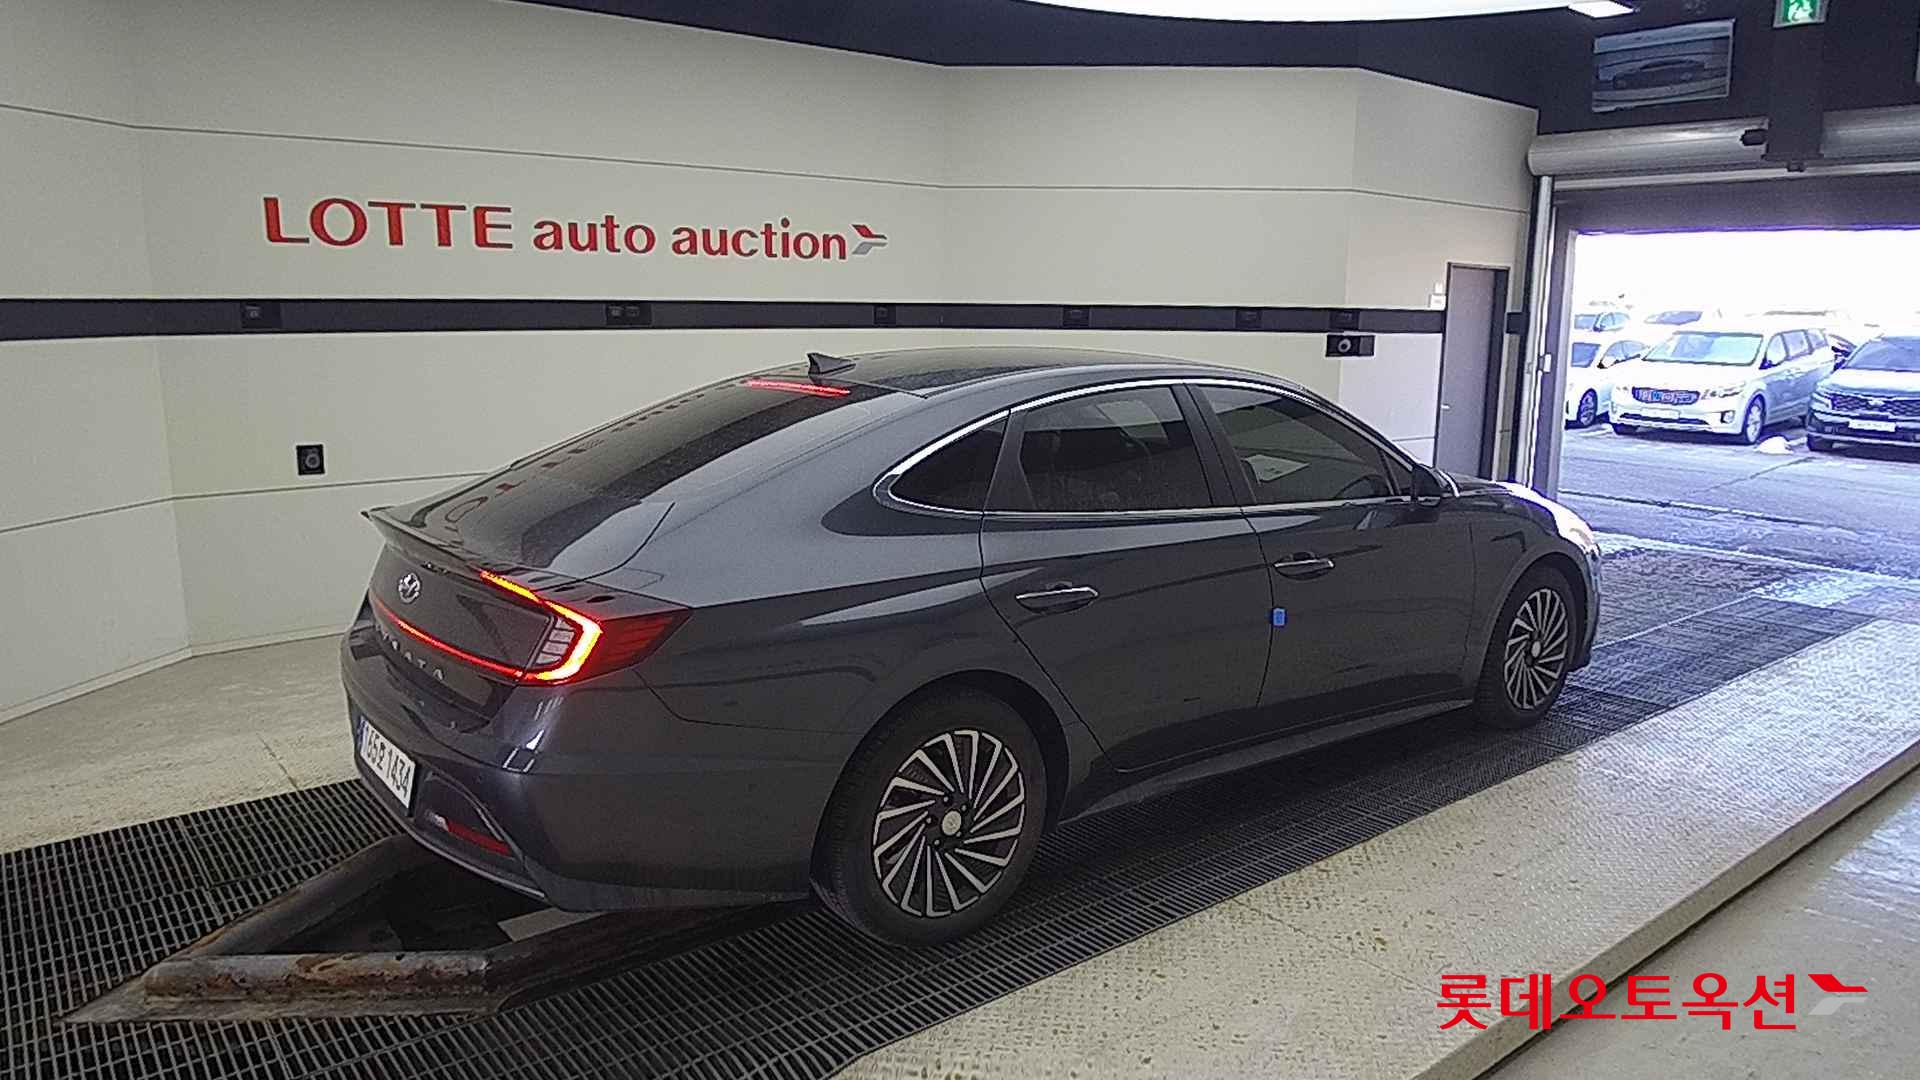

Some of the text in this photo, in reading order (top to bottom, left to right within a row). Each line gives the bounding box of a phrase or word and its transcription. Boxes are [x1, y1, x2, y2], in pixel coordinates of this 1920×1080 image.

[264, 198, 848, 260] LOTTE auto auction
